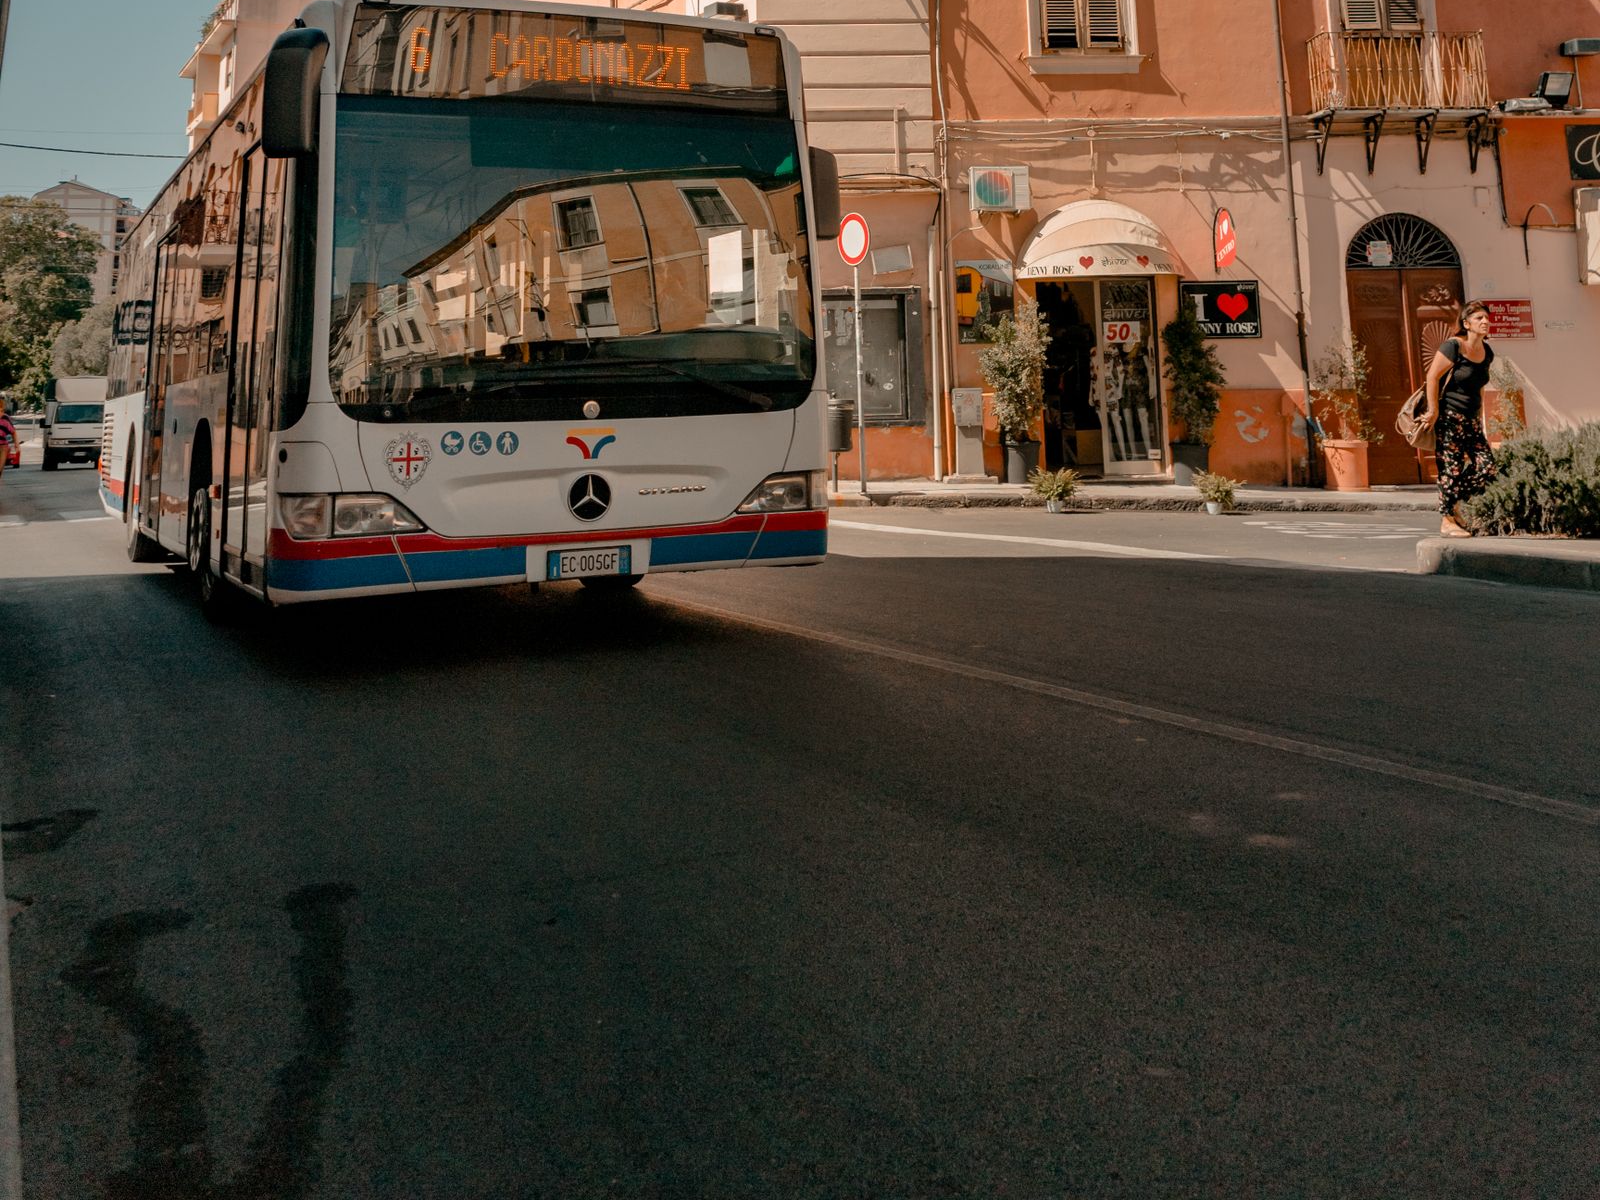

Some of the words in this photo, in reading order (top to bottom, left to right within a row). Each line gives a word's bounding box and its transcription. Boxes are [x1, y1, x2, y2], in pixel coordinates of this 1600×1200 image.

[410, 27, 431, 73] 6
[489, 32, 691, 90] CARBONAZZI
[1053, 265, 1074, 275] ROSE
[1190, 293, 1209, 321] I
[1198, 322, 1222, 334] NNY
